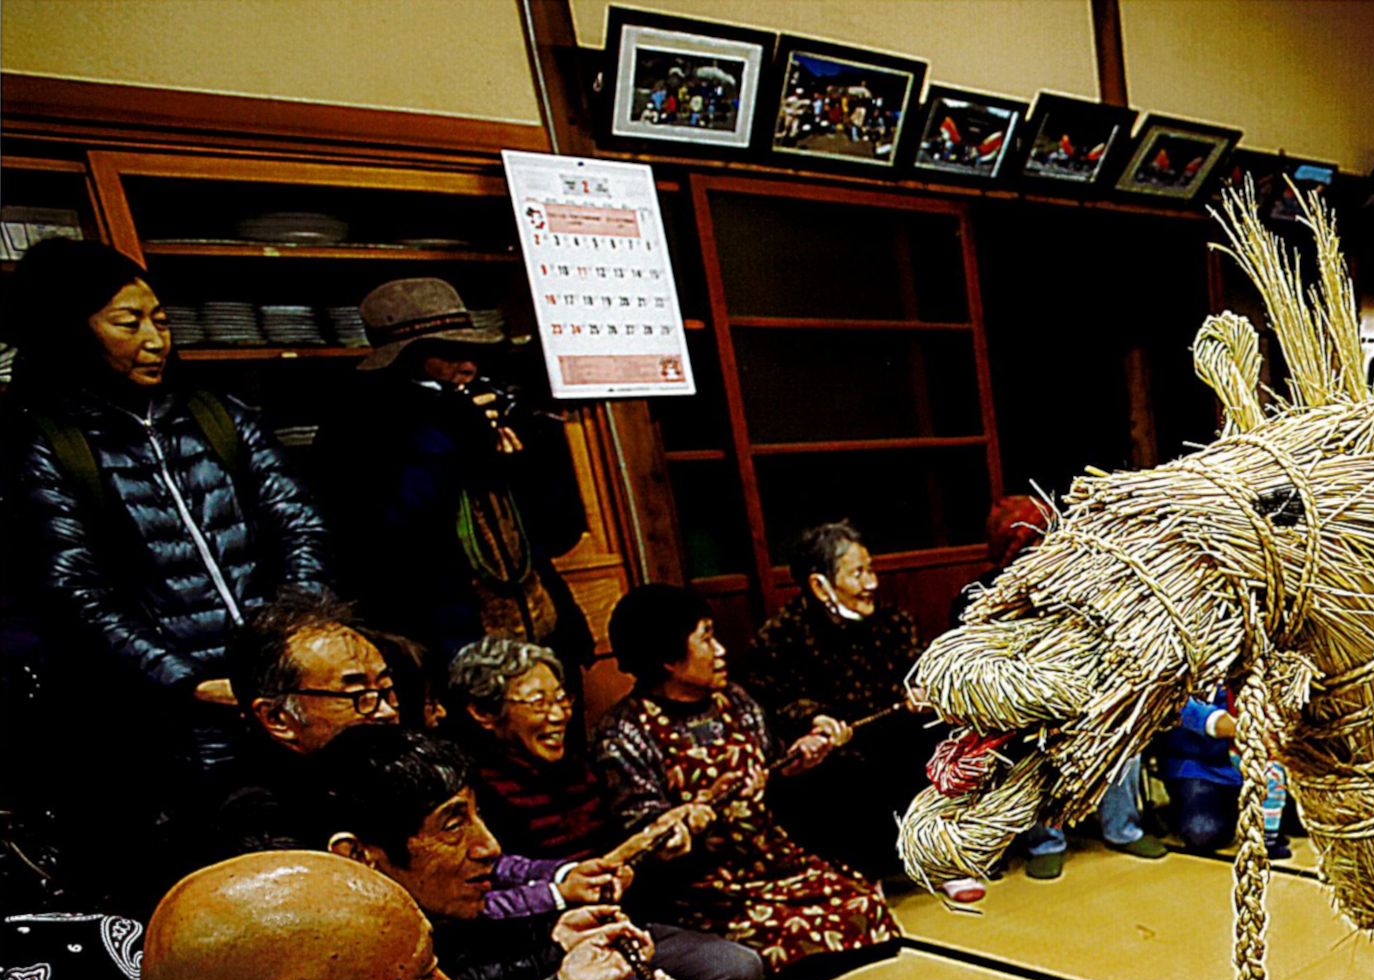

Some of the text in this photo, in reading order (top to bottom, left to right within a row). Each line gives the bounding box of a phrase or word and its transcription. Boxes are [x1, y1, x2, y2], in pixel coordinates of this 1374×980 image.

[533, 234, 541, 246] 2
[553, 234, 561, 247] 3
[557, 265, 570, 277] 10
[576, 266, 589, 277] 11
[595, 267, 607, 278] 12
[613, 267, 625, 279] 13
[631, 268, 642, 278] 14
[563, 294, 575, 306] 17
[582, 295, 594, 307] 18
[600, 295, 612, 307] 19
